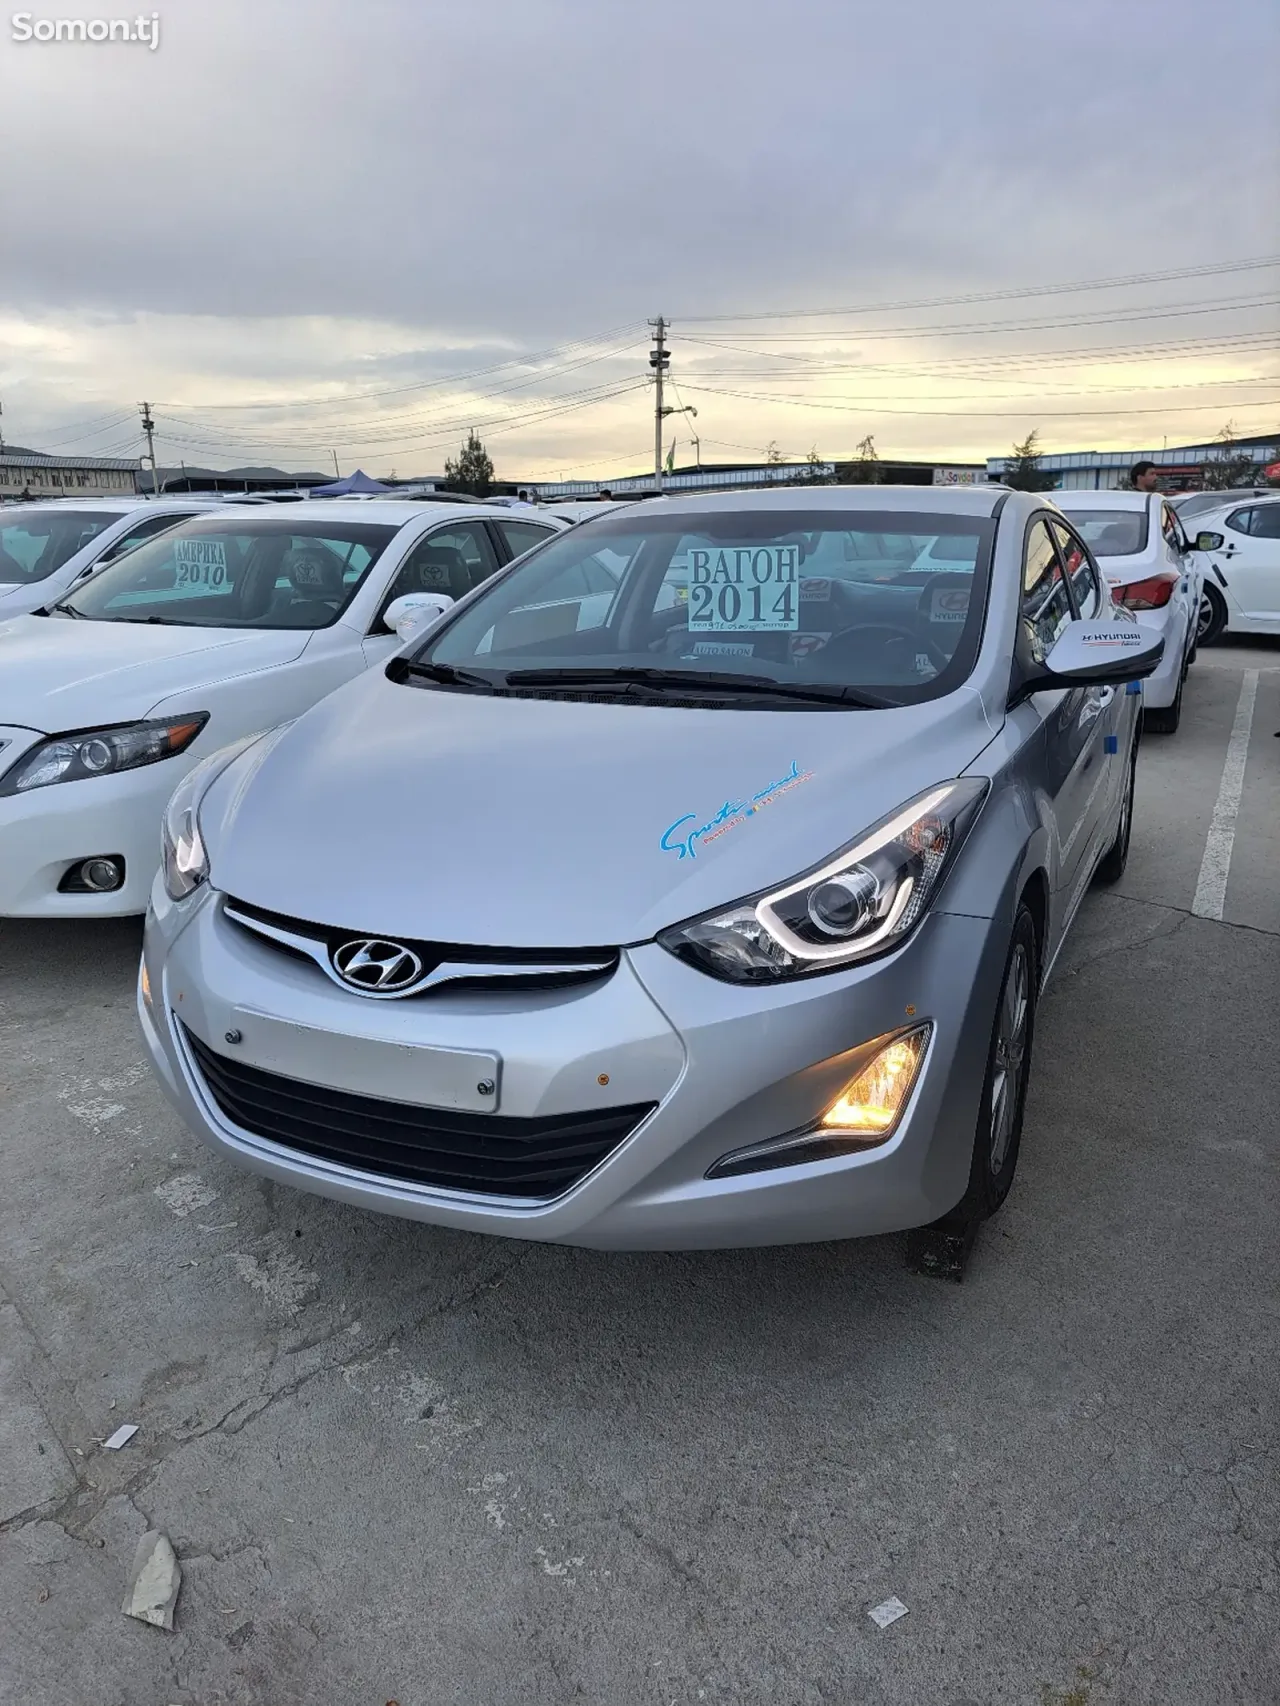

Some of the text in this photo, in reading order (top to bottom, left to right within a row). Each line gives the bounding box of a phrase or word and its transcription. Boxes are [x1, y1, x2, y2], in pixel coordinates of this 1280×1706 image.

[177, 541, 225, 565] АМЕРИКА
[178, 562, 225, 586] 2010
[690, 548, 797, 584] ВАГОН
[690, 584, 796, 622] 2014
[1094, 633, 1141, 641] HYUNDAI
